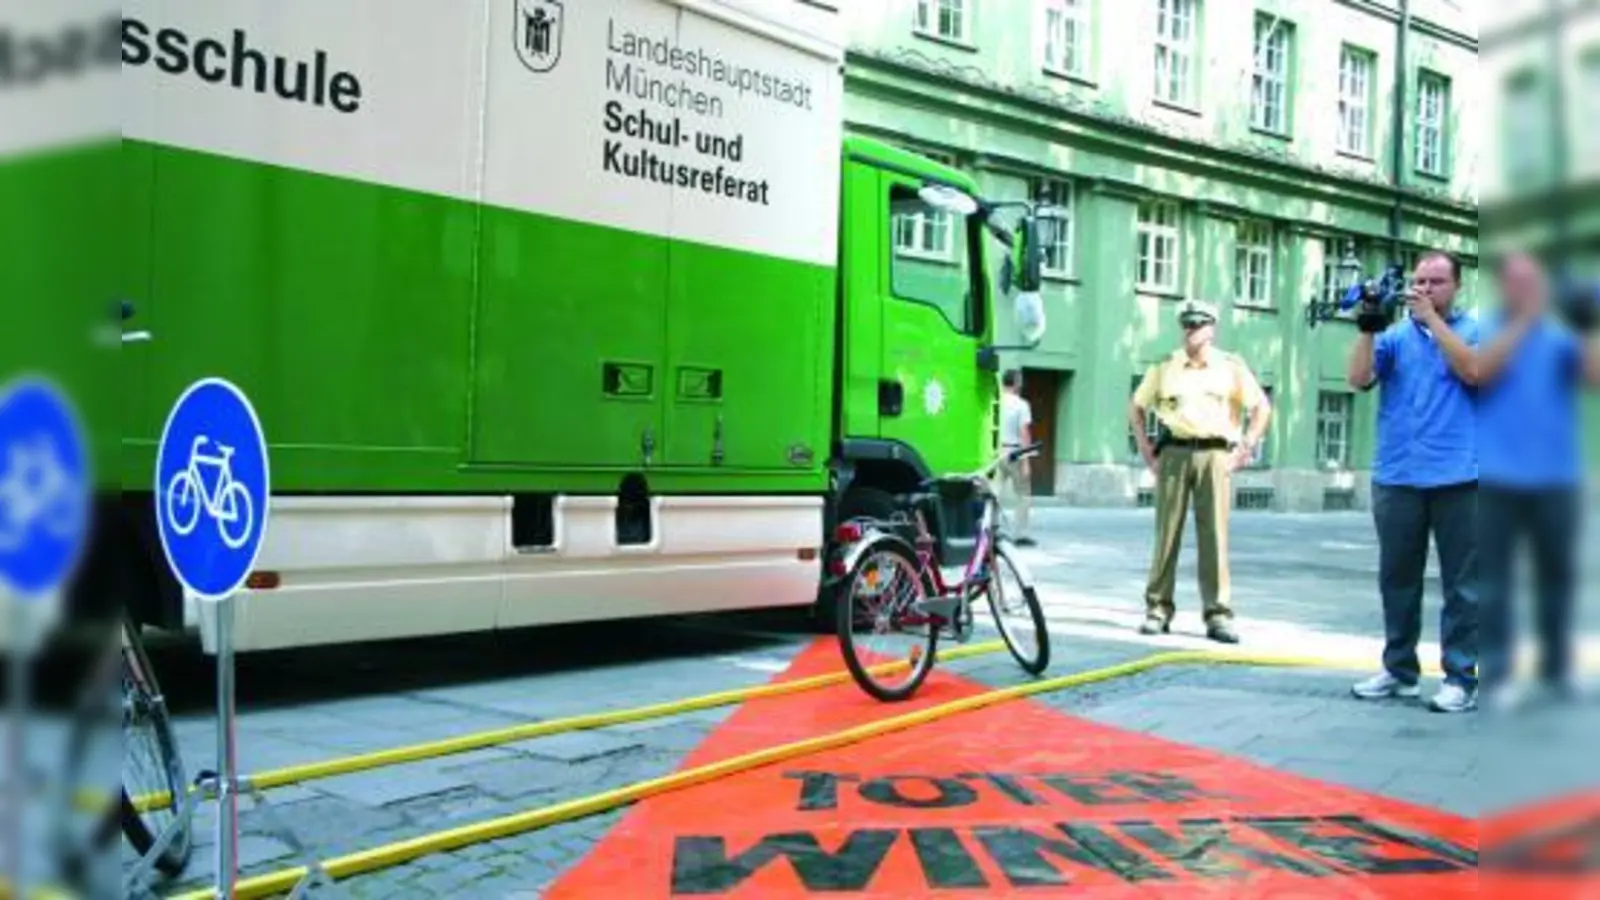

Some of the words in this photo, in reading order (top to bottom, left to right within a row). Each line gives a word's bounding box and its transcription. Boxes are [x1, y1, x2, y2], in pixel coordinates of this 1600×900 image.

[122, 18, 361, 113] sschule
[604, 59, 723, 118] München
[606, 18, 813, 110] Landeshauptstadt
[603, 101, 689, 148] Schul-
[695, 132, 743, 162] und
[603, 140, 769, 206] Kultusreferat
[783, 771, 1208, 811] TOTER
